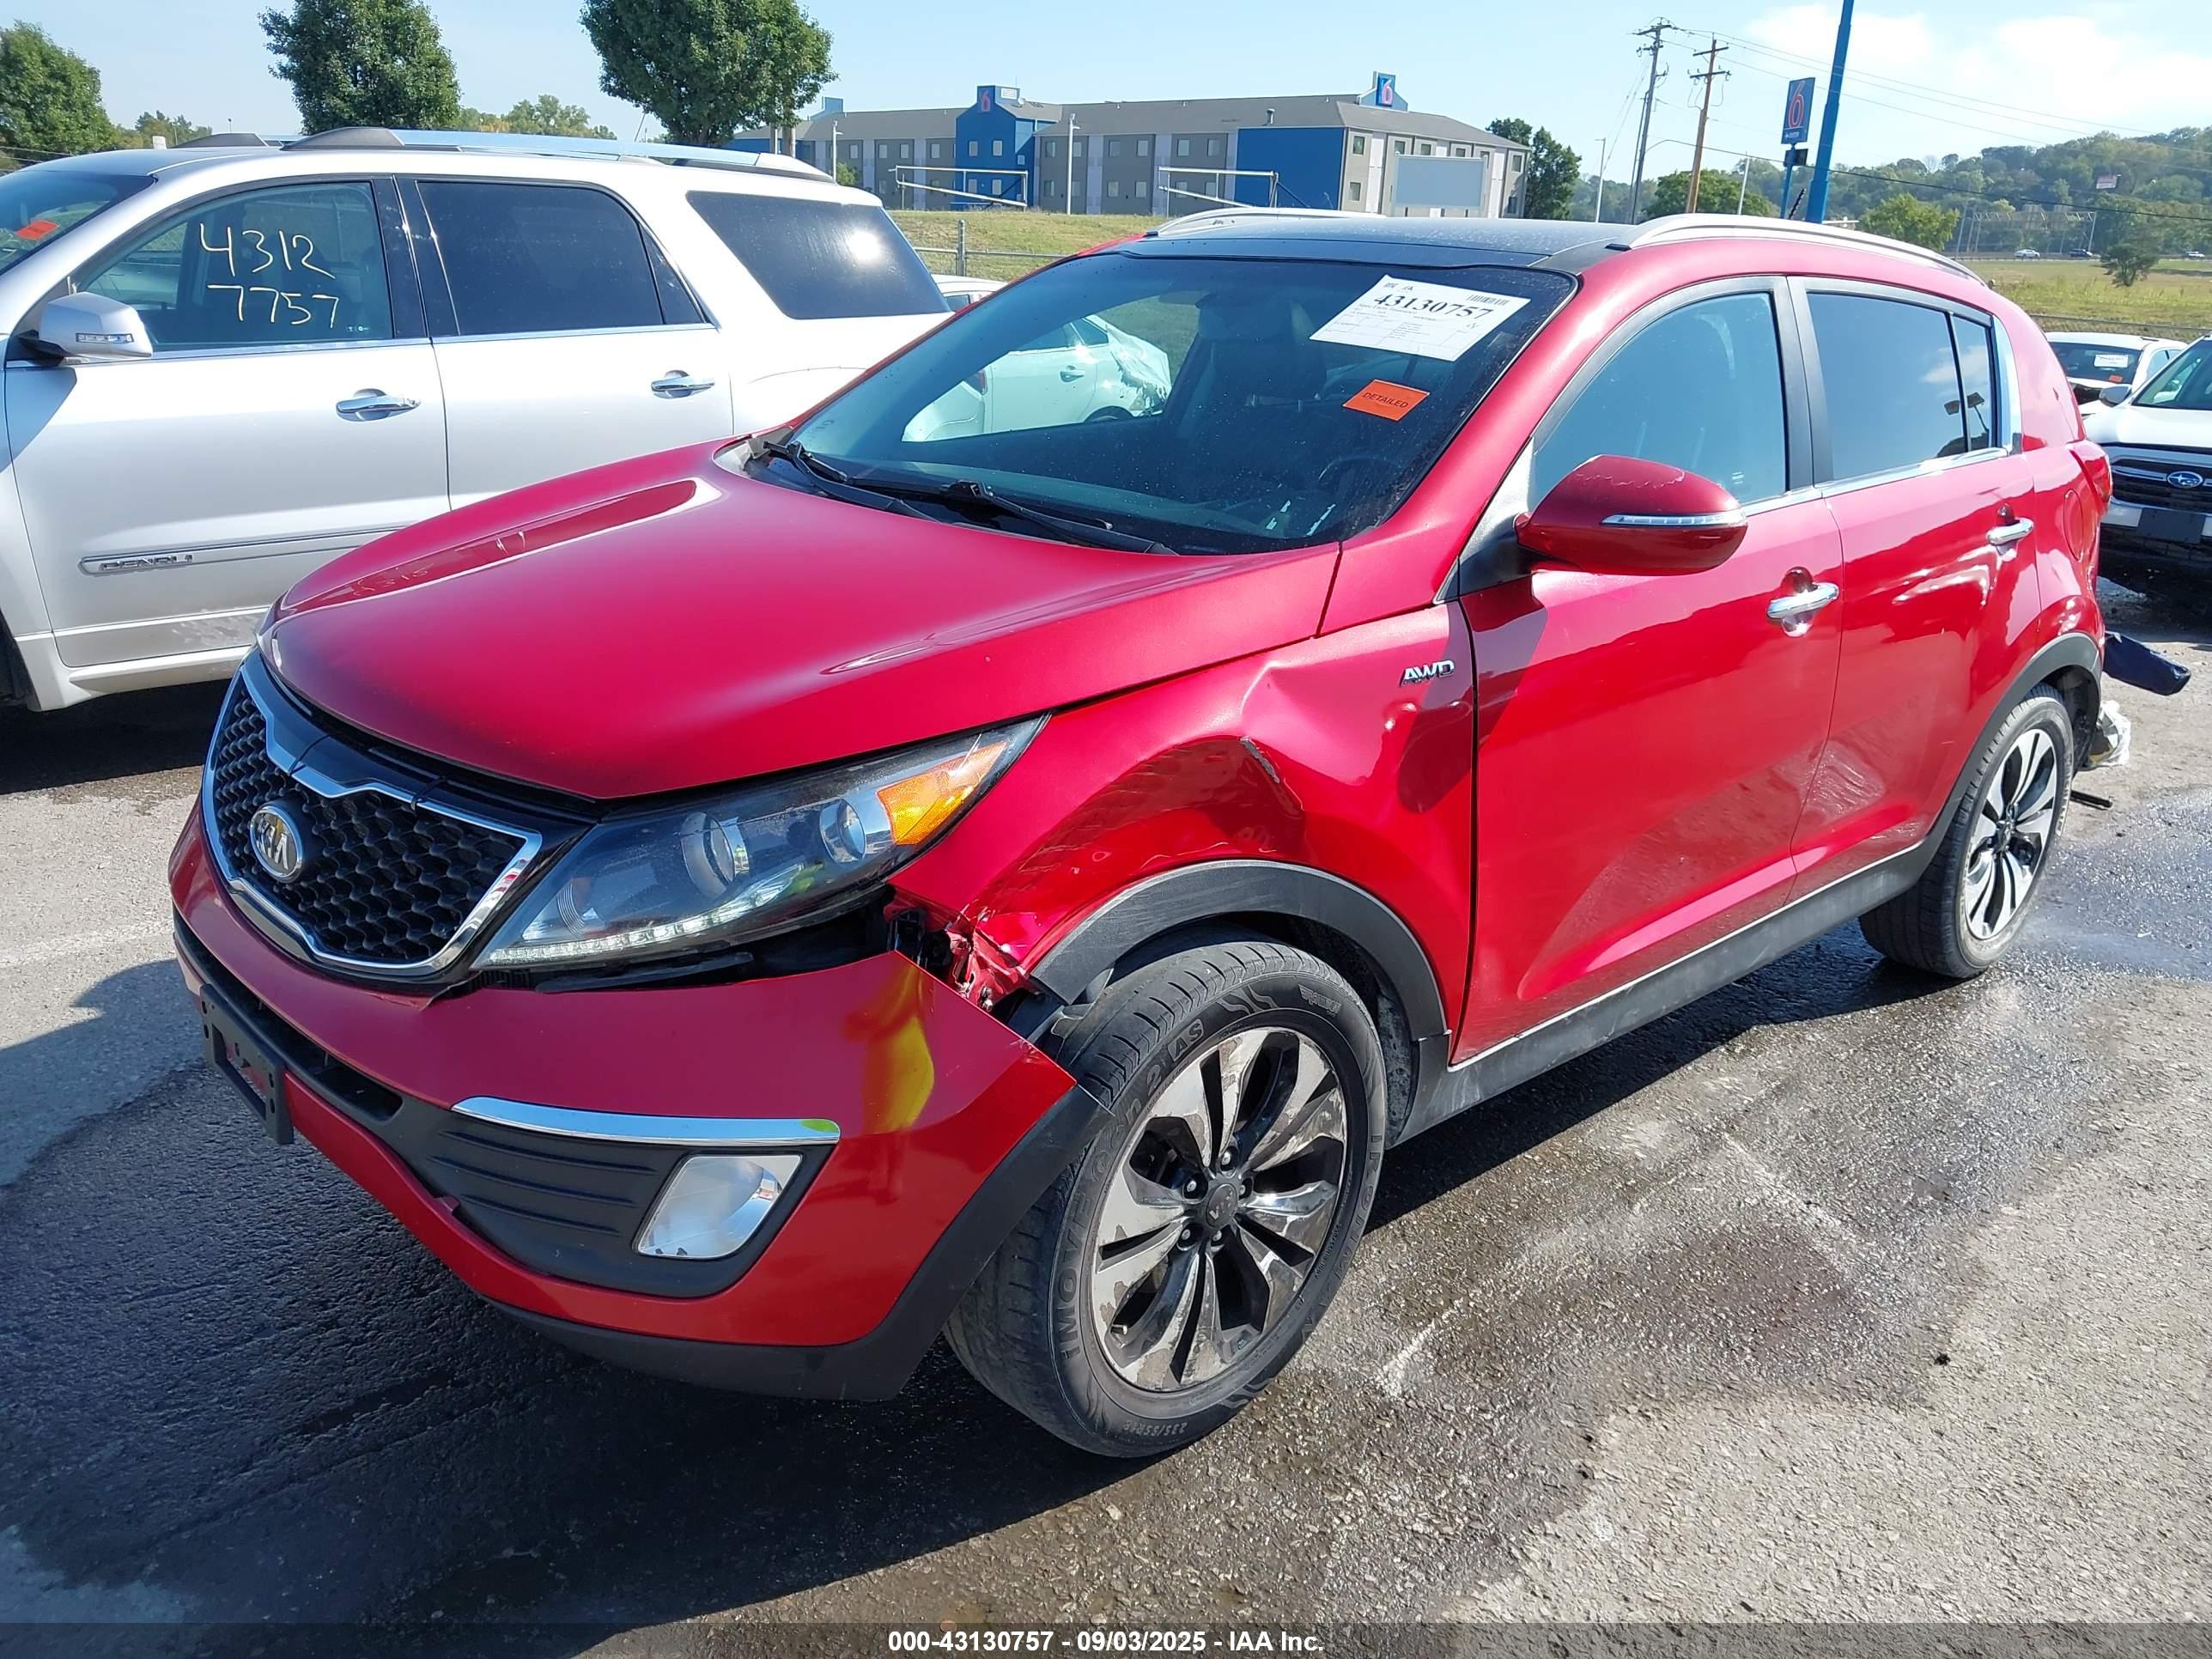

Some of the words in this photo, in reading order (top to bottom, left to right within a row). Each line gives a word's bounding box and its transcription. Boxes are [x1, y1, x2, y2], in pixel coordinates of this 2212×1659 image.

[981, 89, 991, 112] 6
[1382, 79, 1393, 105] 6
[1789, 81, 1805, 129] 6
[200, 222, 337, 279] 4312
[207, 285, 340, 329] 7757
[1373, 293, 1494, 320] 43130757
[1362, 392, 1409, 409] DETAILED
[1399, 659, 1455, 687] AWD
[1173, 1018, 1203, 1060] AS
